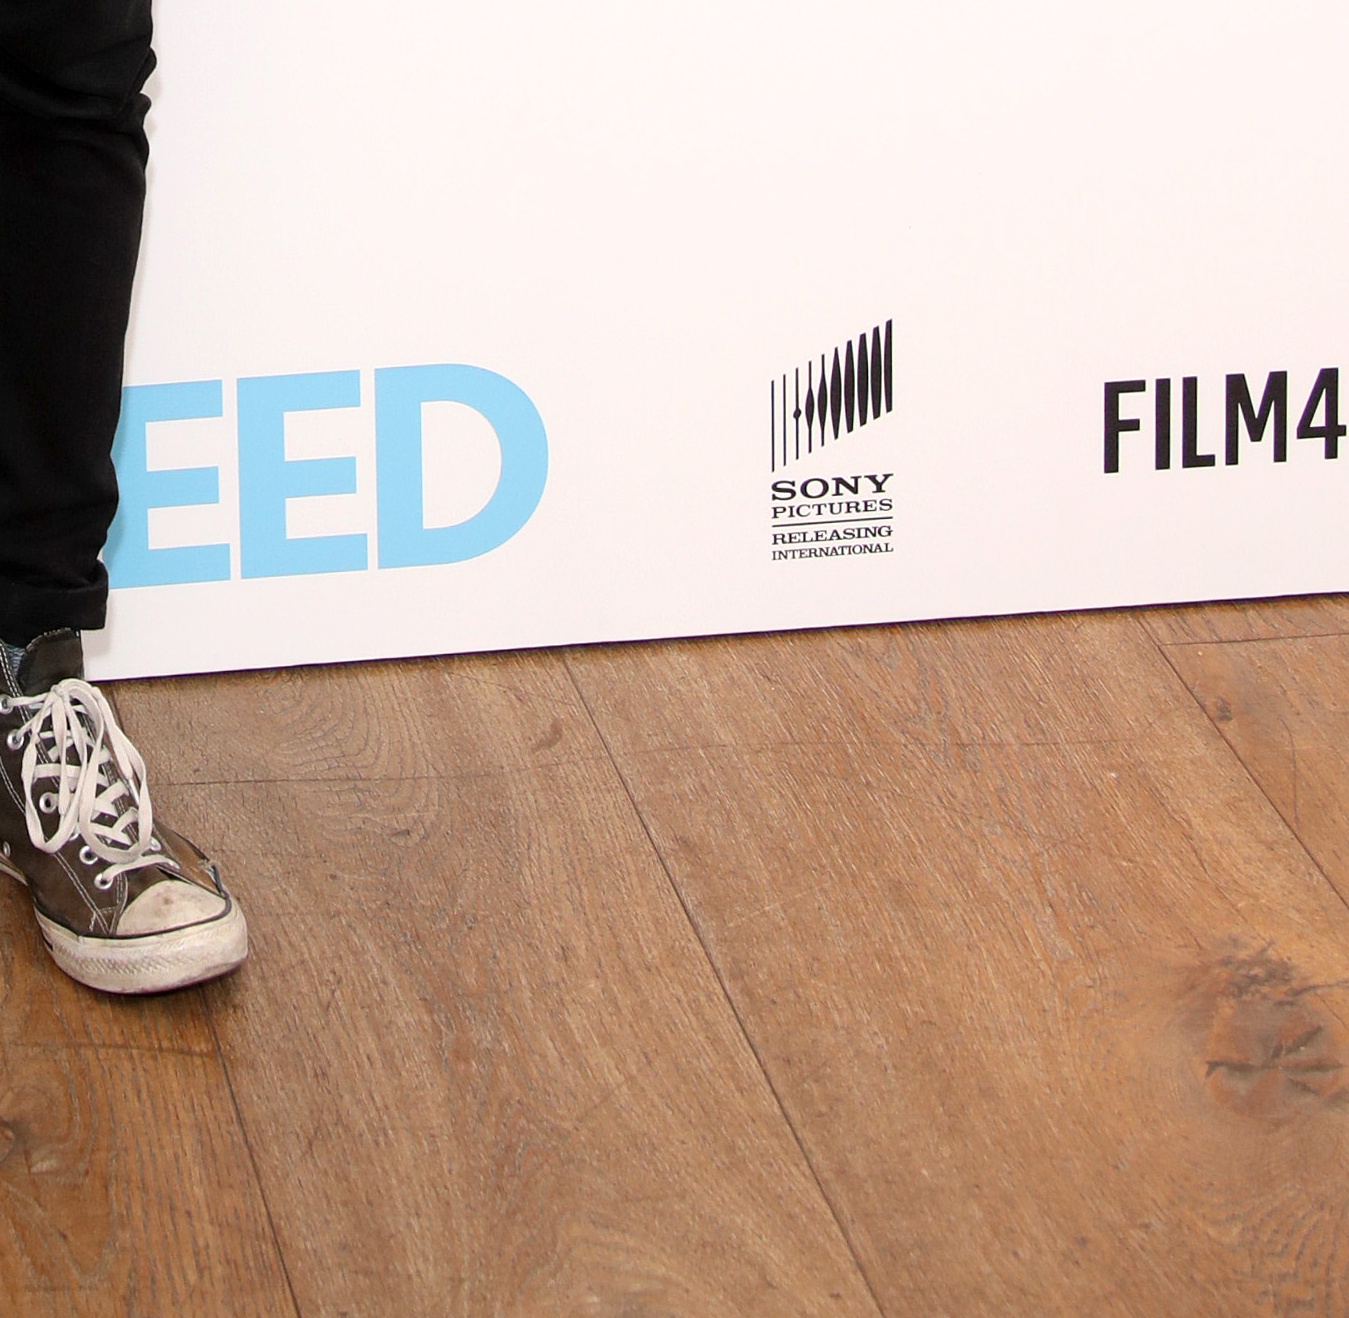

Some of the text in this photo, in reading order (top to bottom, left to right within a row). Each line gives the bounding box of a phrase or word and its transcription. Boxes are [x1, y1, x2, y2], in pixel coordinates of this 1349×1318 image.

[1103, 367, 1347, 474] FILM4
[771, 473, 894, 501] SONY
[772, 498, 893, 519] PICTURES
[772, 525, 893, 546] RELEASING
[772, 542, 894, 561] INTERNATIONAL
